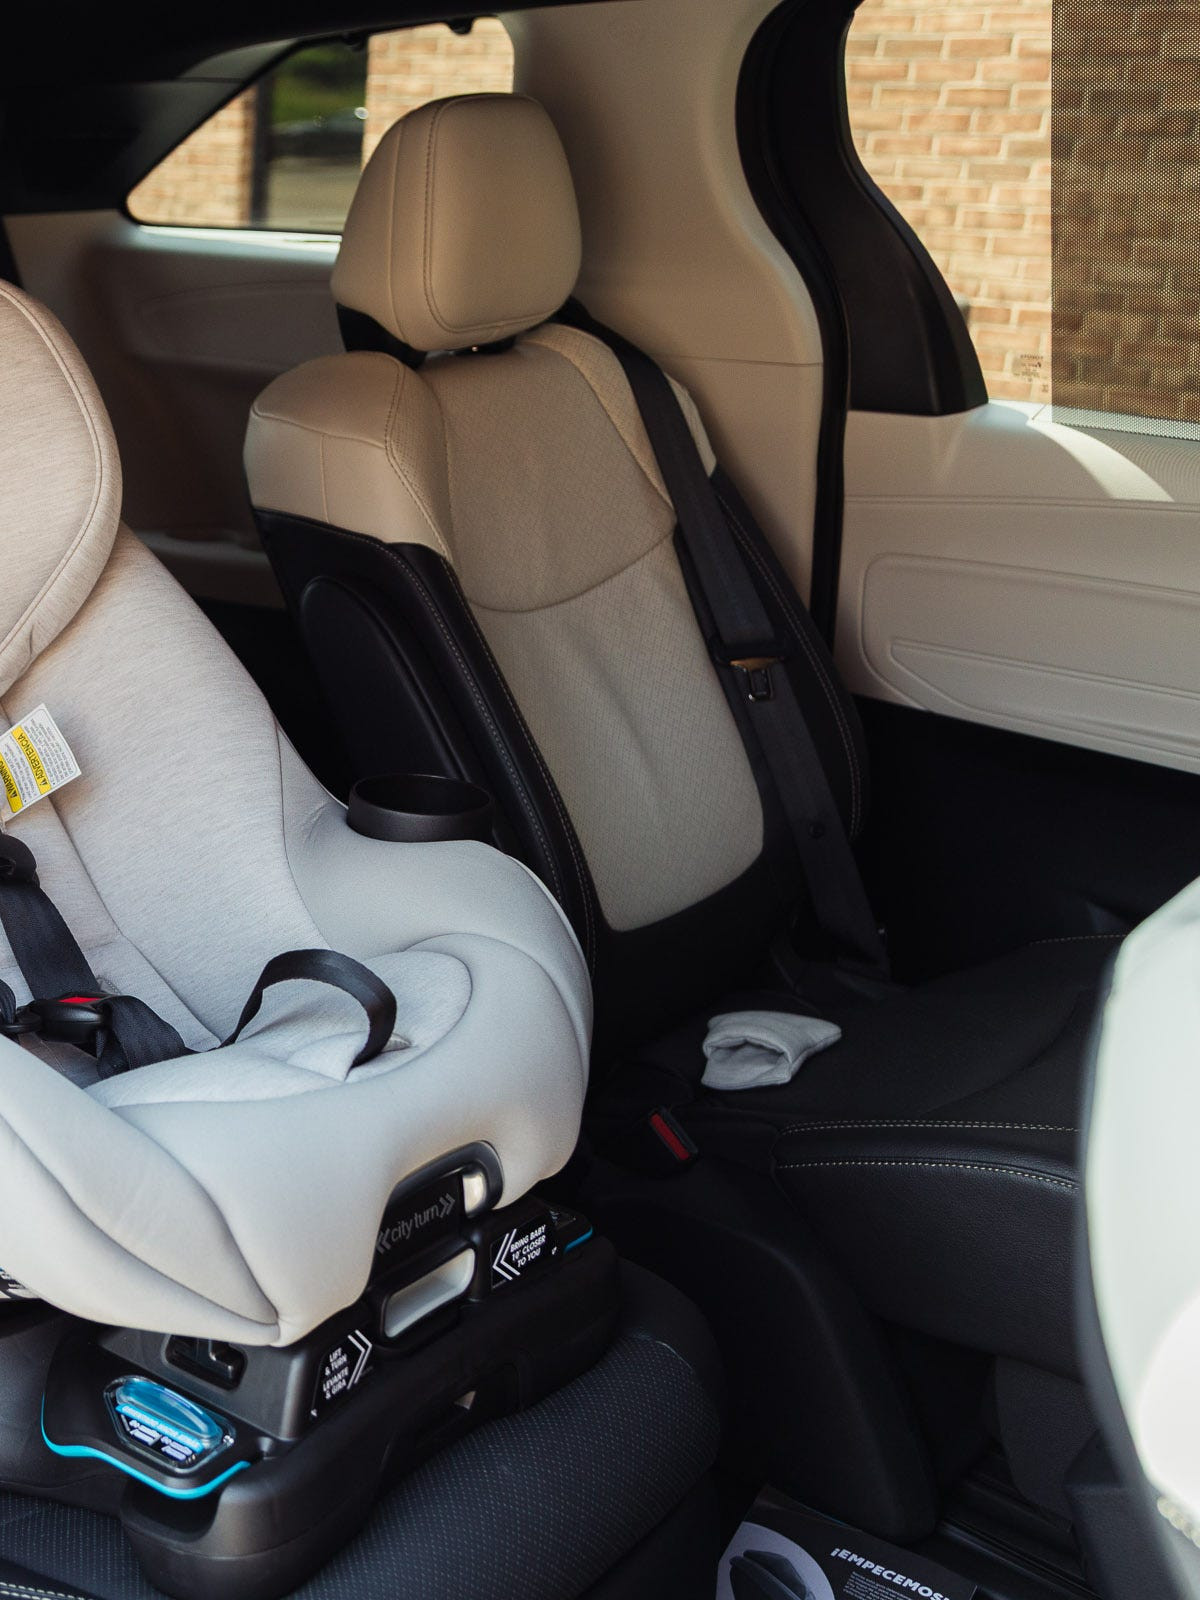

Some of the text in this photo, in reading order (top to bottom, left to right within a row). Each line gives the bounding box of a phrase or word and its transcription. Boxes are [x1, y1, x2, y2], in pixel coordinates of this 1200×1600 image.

[17, 733, 45, 779] ADVERTENCIA
[391, 1204, 439, 1242] city turn
[510, 1224, 546, 1253] BRING BABY
[522, 1235, 546, 1255] CLOSER
[517, 1247, 541, 1268] TO YOU
[329, 1347, 342, 1363] LIFT
[322, 1366, 349, 1392] LEVANTE
[331, 1378, 347, 1395] GIRA
